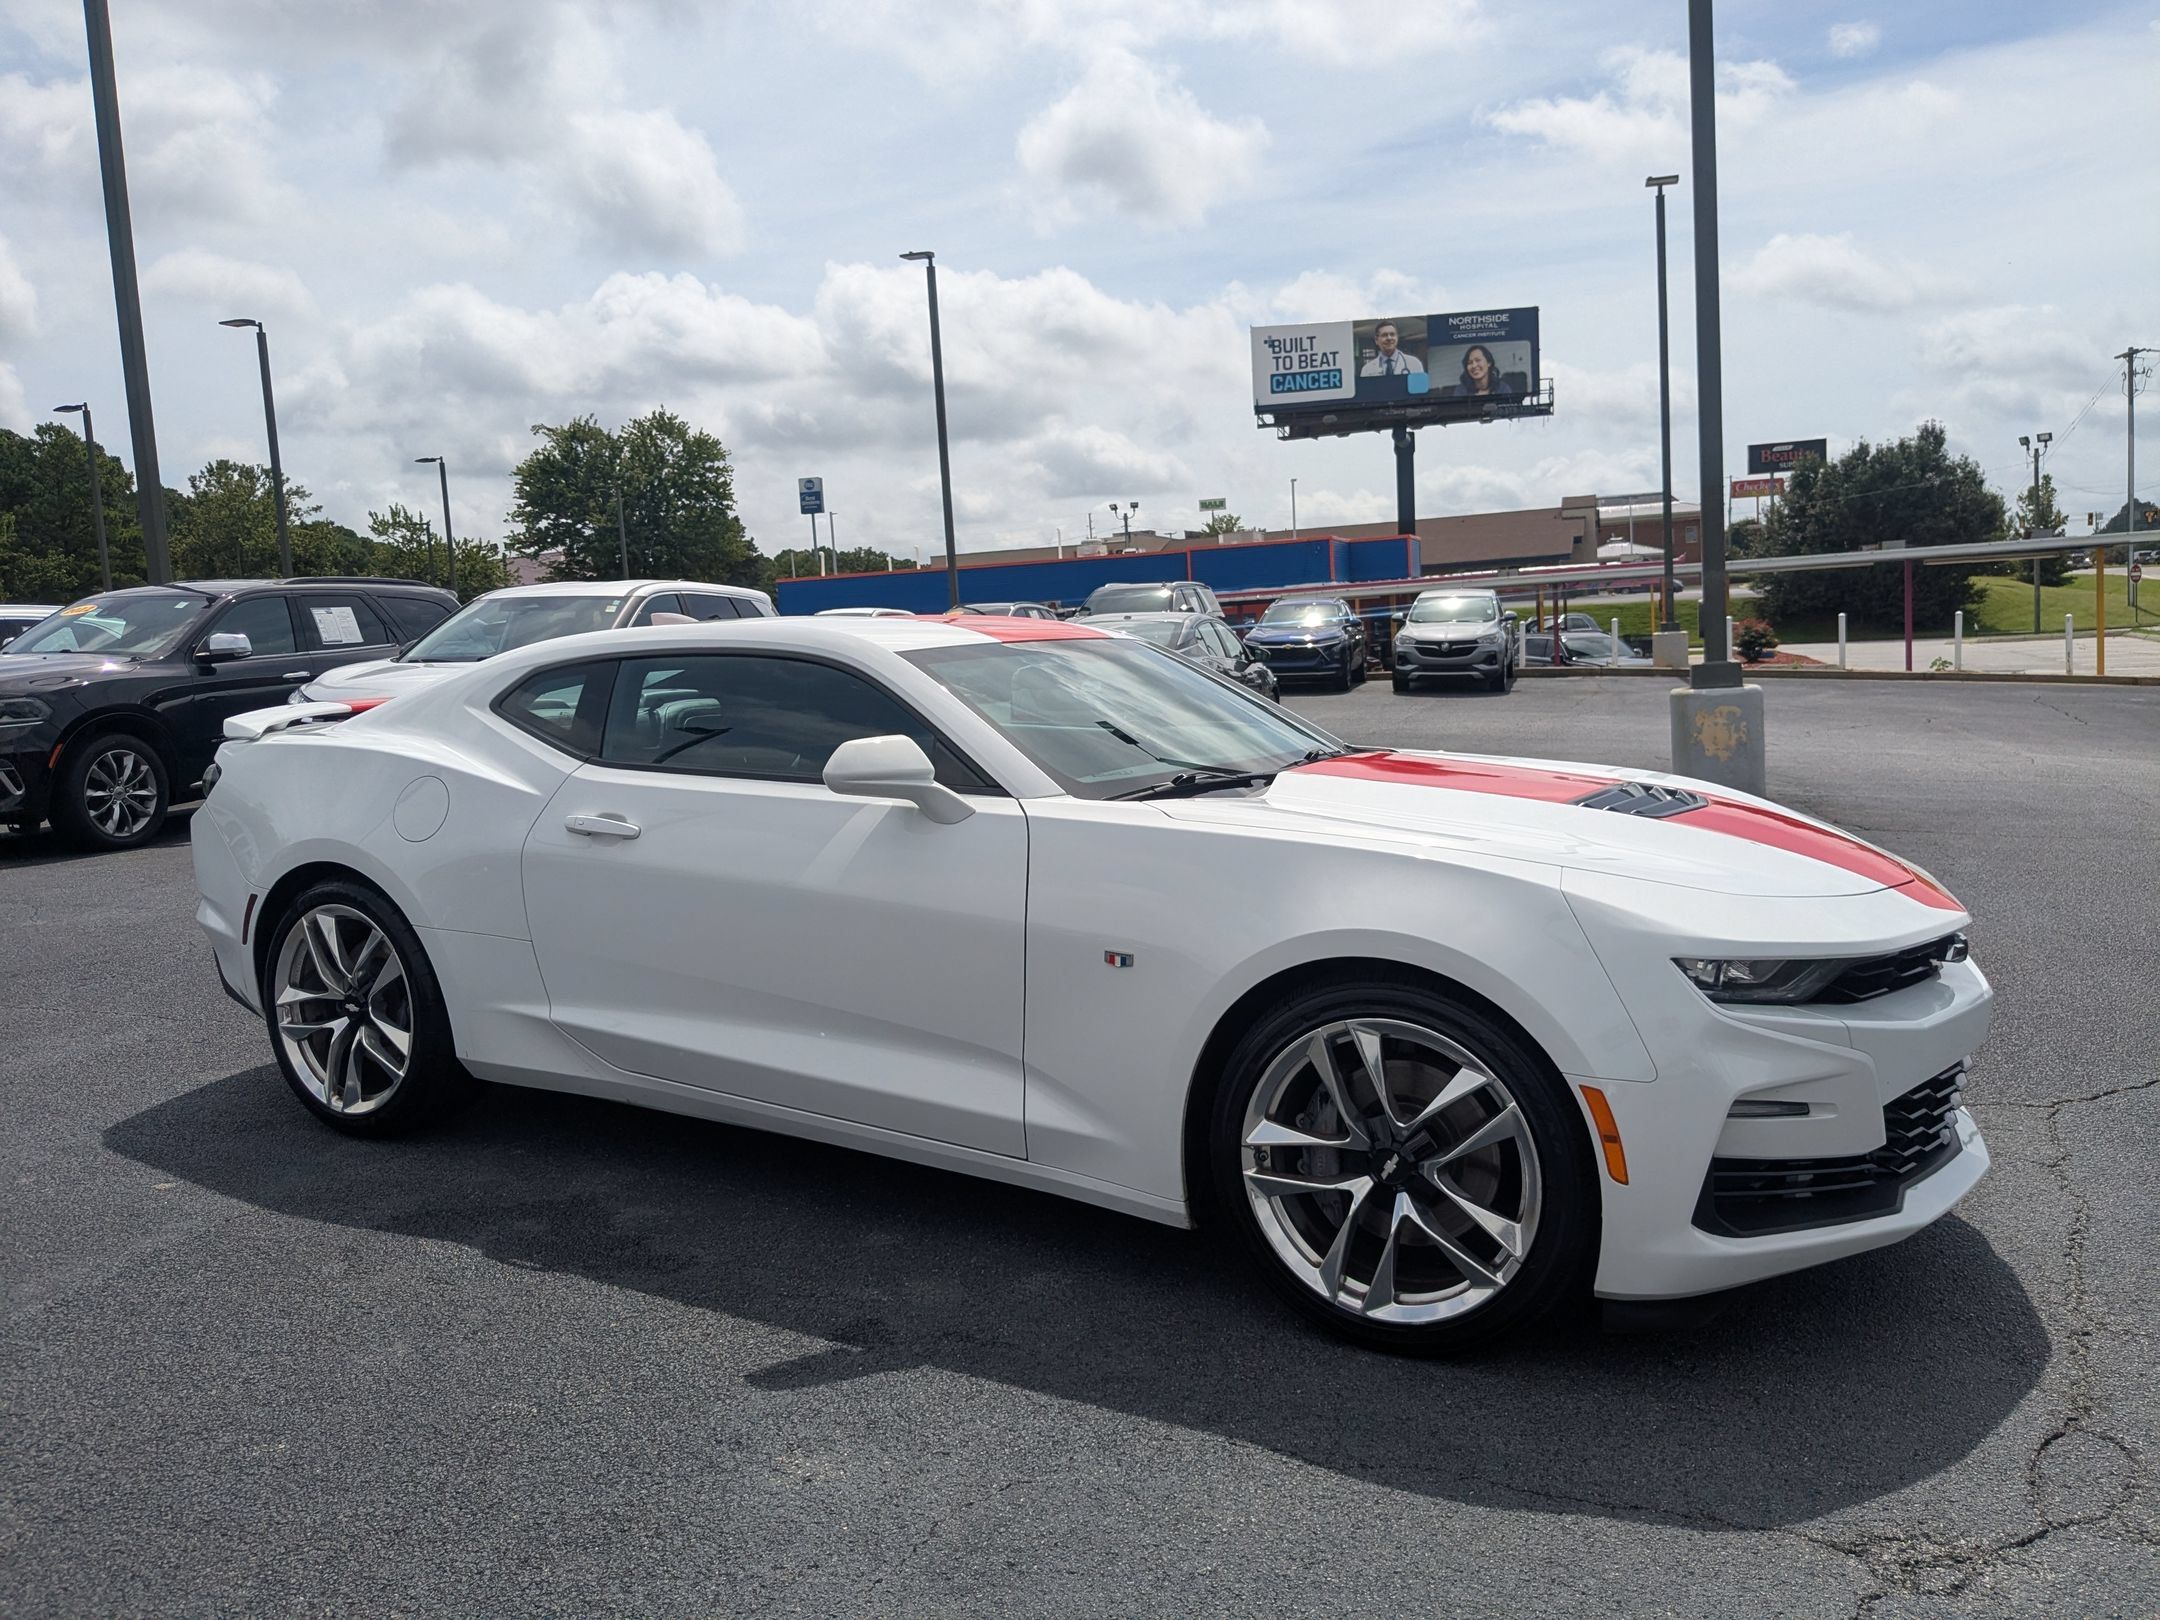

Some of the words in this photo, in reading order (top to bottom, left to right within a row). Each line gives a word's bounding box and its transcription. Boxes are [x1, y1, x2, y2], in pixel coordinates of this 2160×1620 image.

[1448, 314, 1510, 325] NORTHSIDE
[1272, 336, 1316, 354] BUILT
[1272, 355, 1293, 371] TO
[1298, 351, 1339, 370] BEAT
[1272, 371, 1341, 391] CANCER
